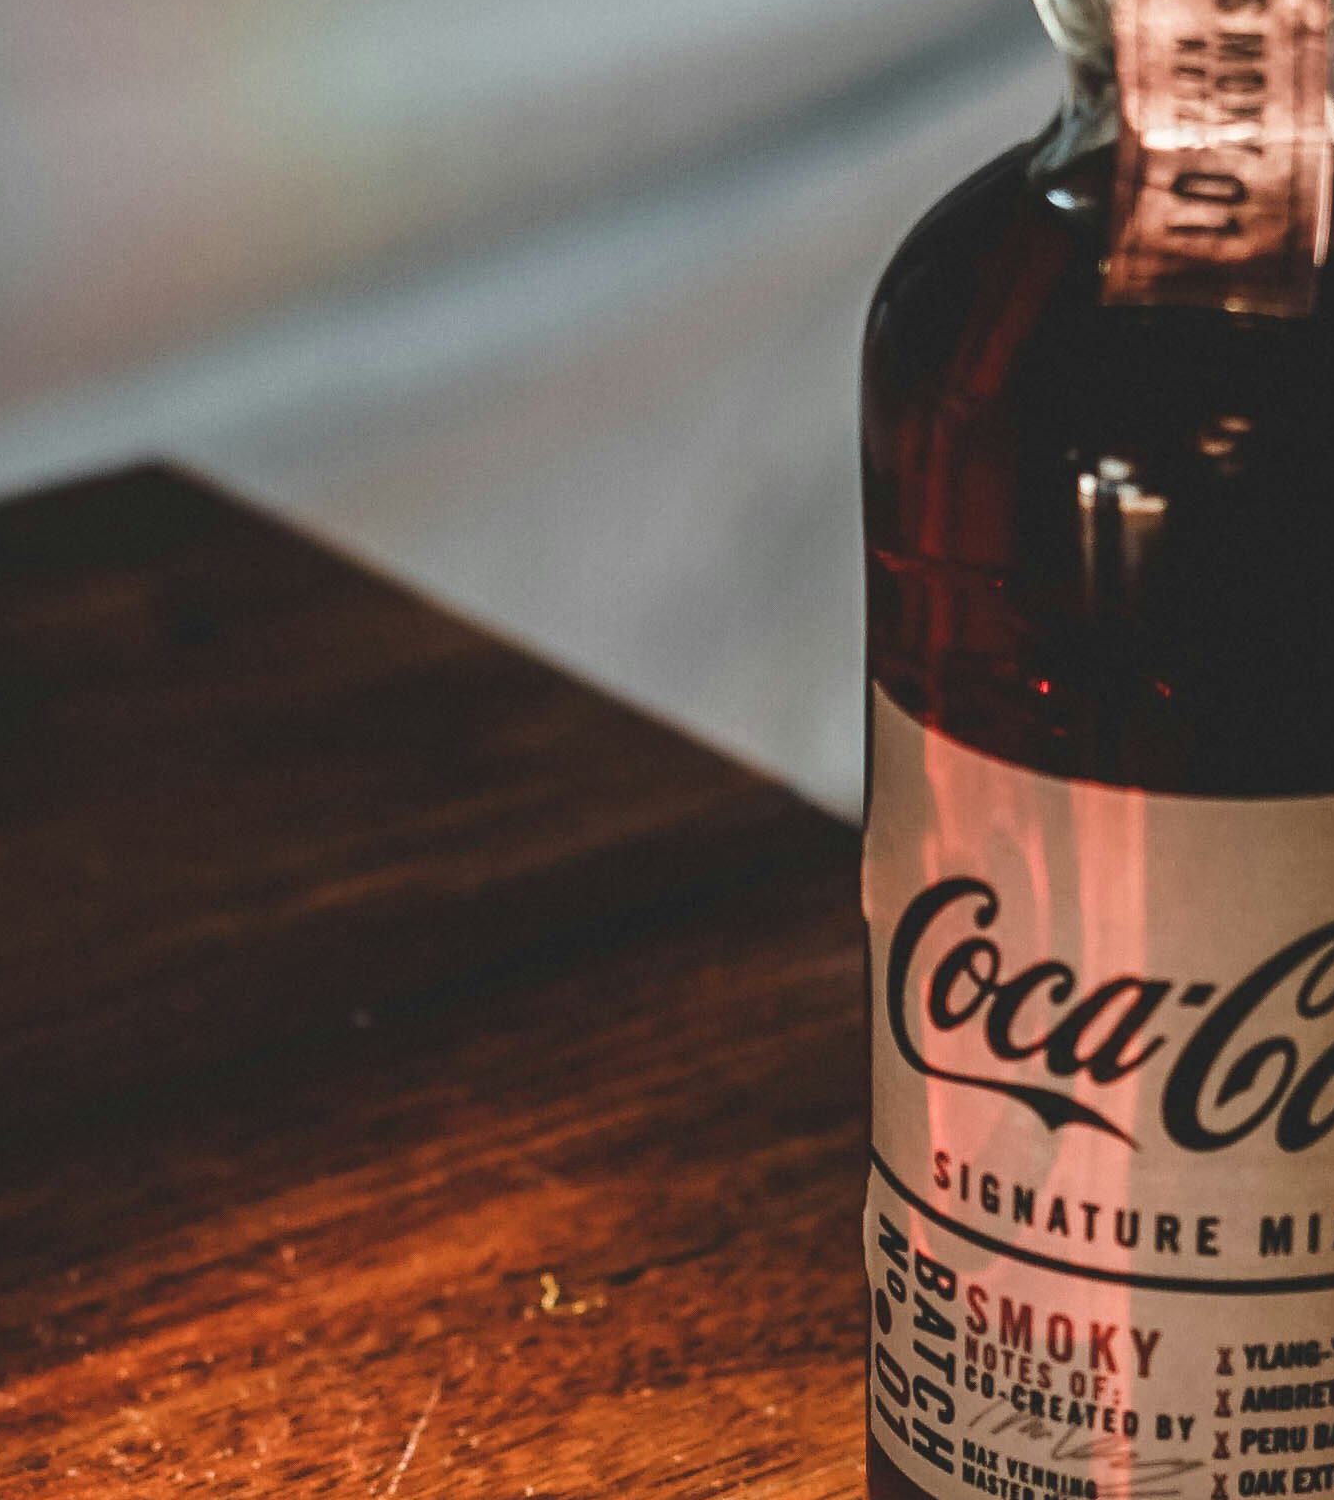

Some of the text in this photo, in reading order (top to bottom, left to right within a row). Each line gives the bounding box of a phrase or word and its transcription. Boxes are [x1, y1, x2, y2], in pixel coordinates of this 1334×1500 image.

[932, 1151, 1222, 1257] SIGNATURE
[912, 1249, 957, 1475] BATCH
[965, 1284, 1162, 1379] SMOKY
[964, 1333, 1120, 1406] NOTES OF:
[964, 1364, 1196, 1442] CO-CREATED BY
[962, 1437, 1099, 1500] MAX VENNING
[1239, 1425, 1308, 1455] PERU
[1238, 1468, 1287, 1497] OAK
